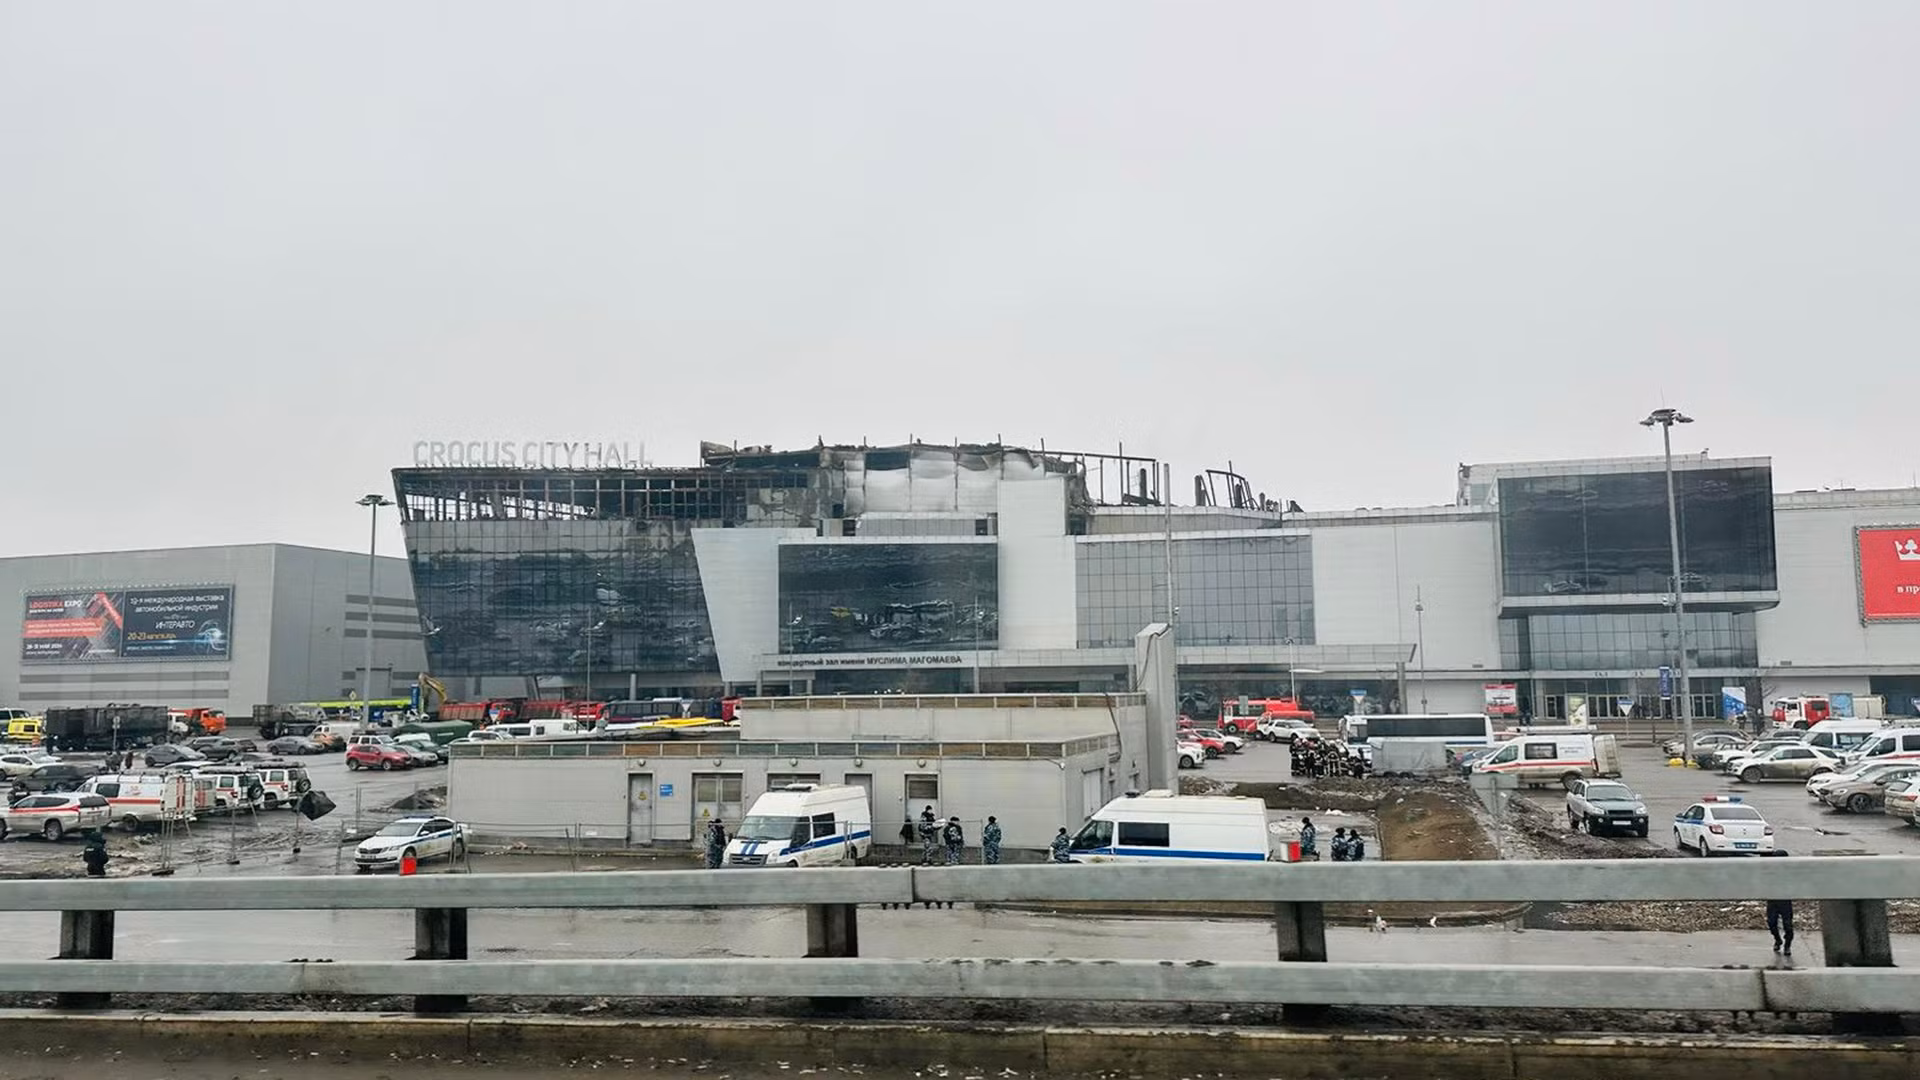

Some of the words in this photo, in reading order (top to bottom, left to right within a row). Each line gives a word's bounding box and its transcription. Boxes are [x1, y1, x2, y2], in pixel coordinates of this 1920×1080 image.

[413, 440, 516, 465] CROCUS
[521, 441, 578, 466] CITY
[583, 441, 652, 466] HALL
[1906, 585, 1920, 595] пр
[155, 620, 194, 629] ИНТЕРАВТО
[909, 656, 962, 664] МАГОМАЕВА
